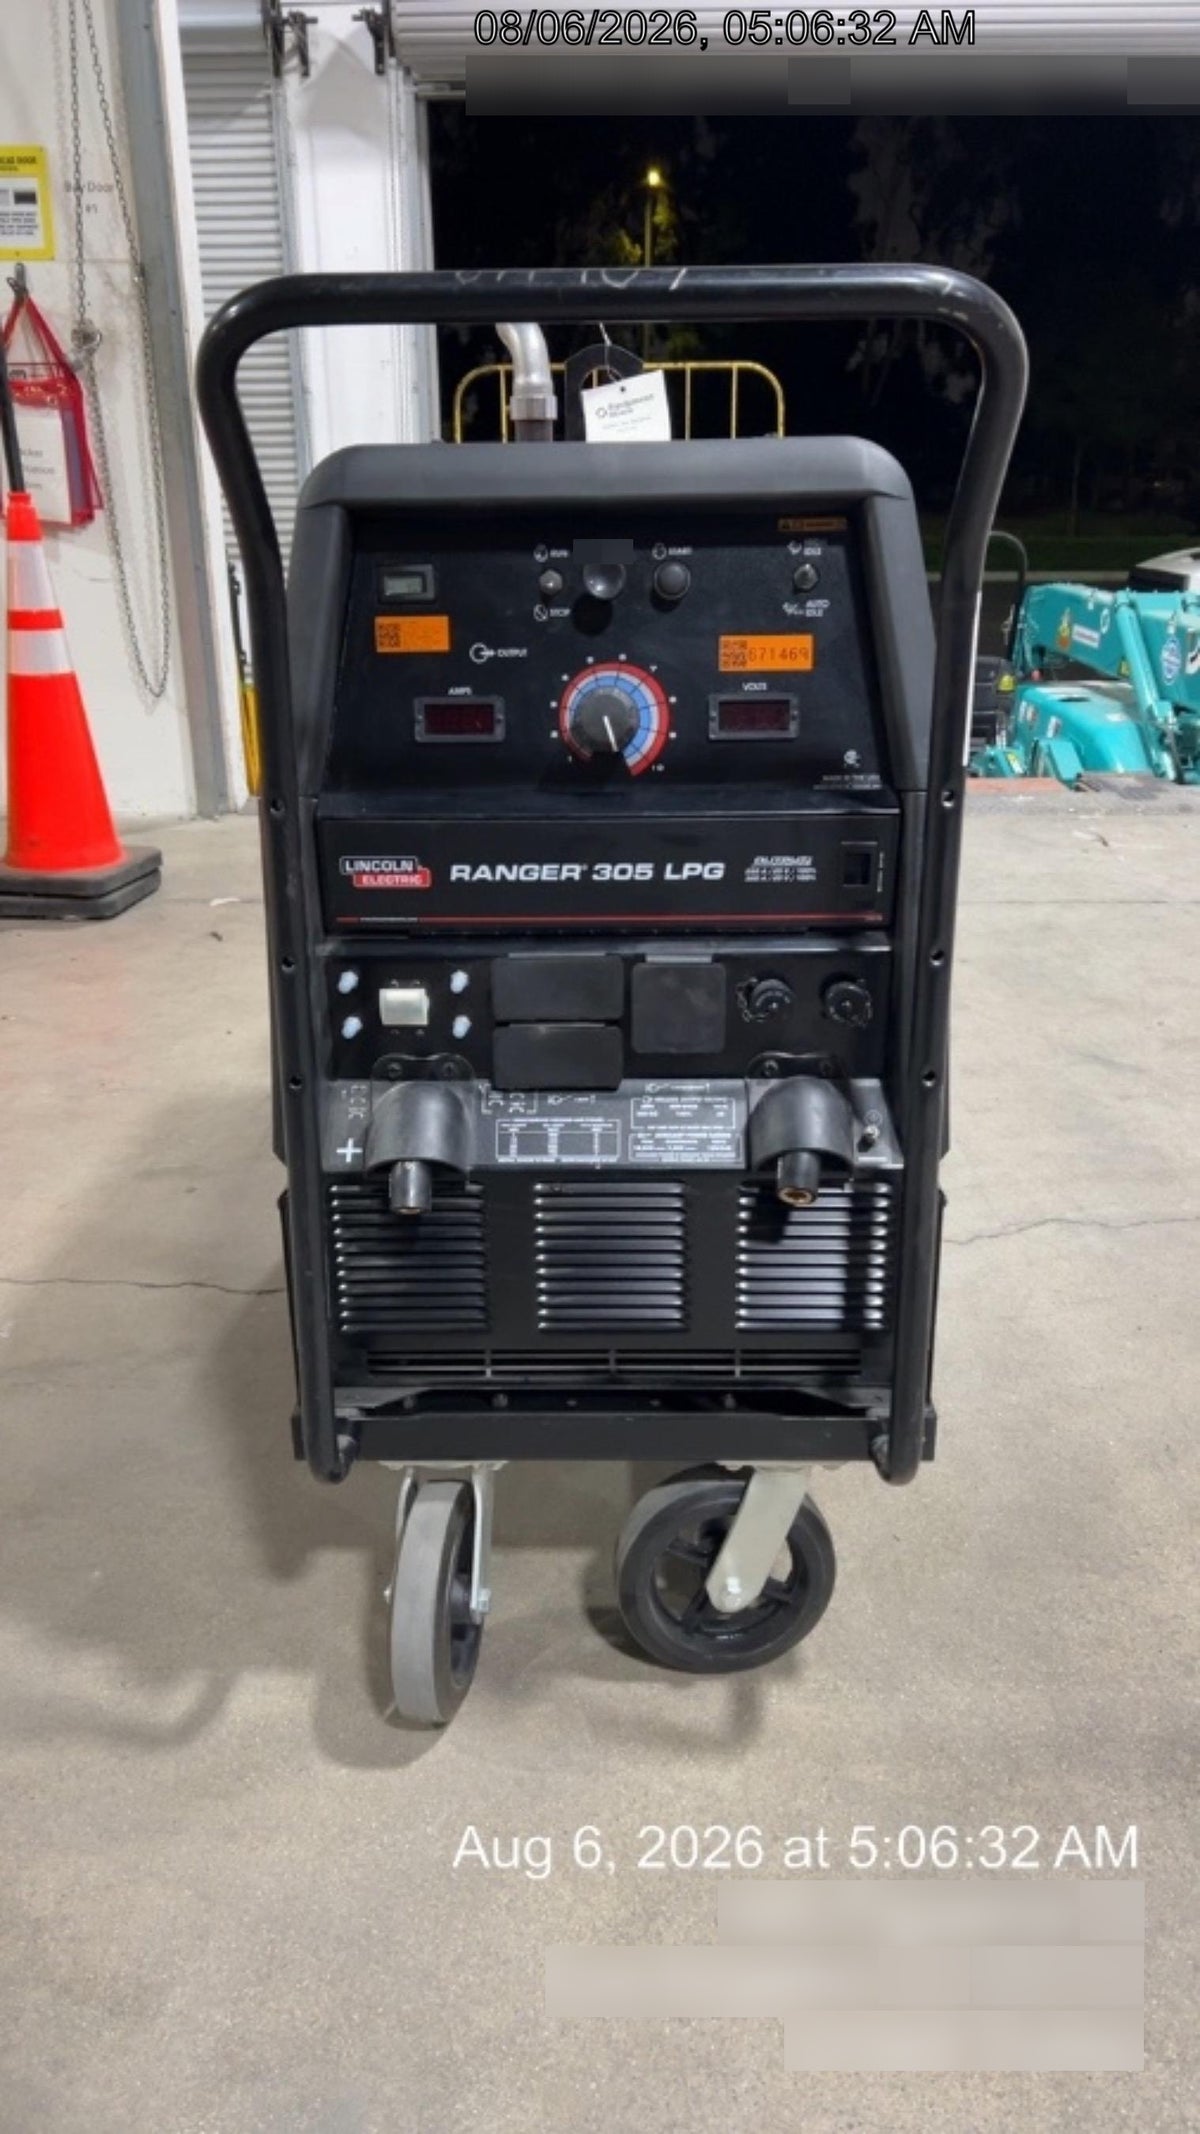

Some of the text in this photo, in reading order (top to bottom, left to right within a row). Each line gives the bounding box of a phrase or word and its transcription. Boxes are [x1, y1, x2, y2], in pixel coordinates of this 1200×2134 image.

[497, 648, 528, 658] OUTPUT
[345, 859, 414, 872] LINCOLN
[592, 862, 655, 881] 305
[664, 862, 726, 881] LPG
[362, 873, 424, 886] ELECTRIC
